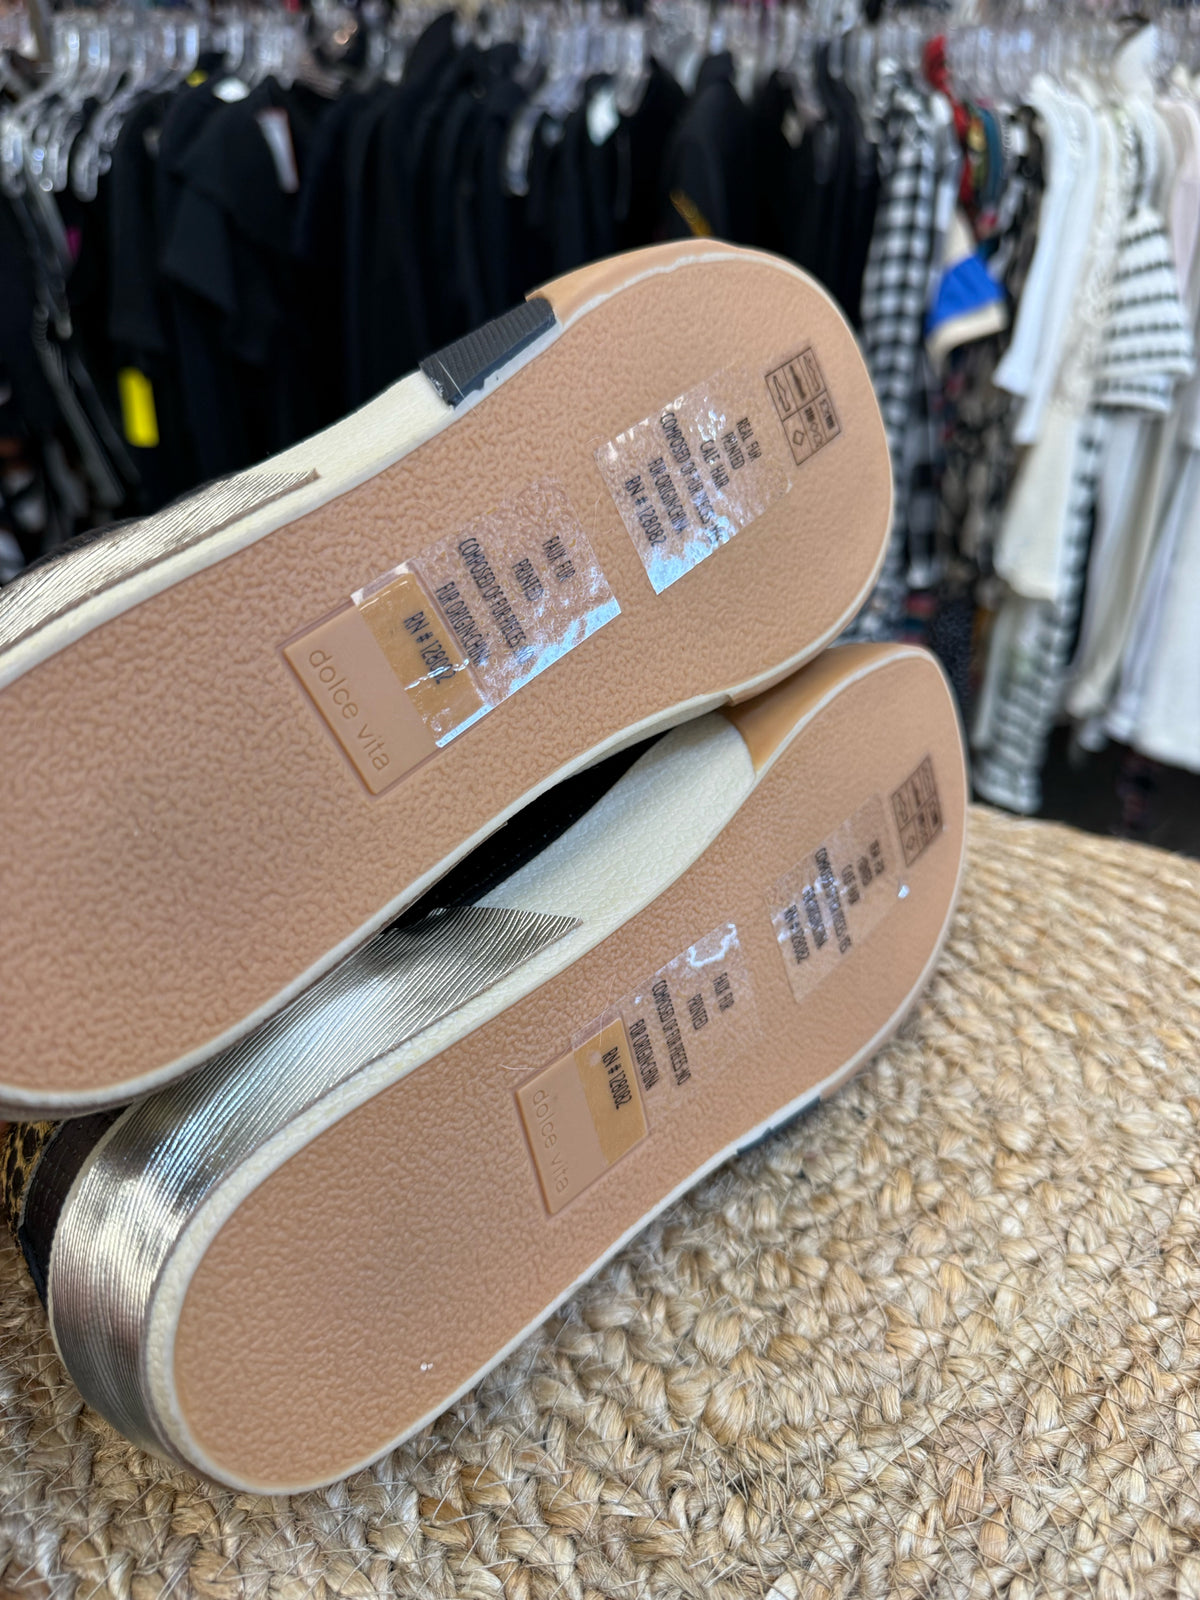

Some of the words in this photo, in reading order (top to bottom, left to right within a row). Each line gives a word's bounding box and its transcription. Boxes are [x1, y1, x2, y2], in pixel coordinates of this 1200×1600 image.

[660, 412, 690, 463] COMPOSED
[737, 417, 754, 442] REAL
[746, 441, 762, 462] FUR
[721, 432, 745, 470] PRINTED
[648, 457, 666, 478] FUR
[681, 462, 697, 478] OF
[700, 439, 720, 464] CALF
[710, 465, 729, 490] HAIR
[625, 475, 645, 497] RN
[686, 474, 704, 496] FUR
[635, 496, 646, 506] #
[638, 504, 666, 547] 128082
[459, 538, 495, 589] COMPOSED
[542, 536, 566, 567] FAUX
[555, 560, 575, 582] FUR
[512, 558, 544, 601] PRINTED
[436, 581, 460, 605] FUR
[483, 586, 503, 599] OF
[489, 597, 511, 620] FUR
[404, 611, 430, 636] RN
[500, 613, 526, 649] PIECES
[416, 632, 433, 643] #
[309, 650, 358, 719] dolce
[358, 724, 390, 770] vita
[713, 972, 730, 995] FAUX
[652, 980, 674, 1022] COMPOSED
[688, 993, 708, 1030] PRINTED
[720, 992, 735, 1012] FUR
[630, 1018, 646, 1039] FUR
[663, 1019, 678, 1033] OF
[666, 1028, 681, 1048] FUR
[602, 1046, 620, 1068] RN
[670, 1042, 688, 1072] PIECES
[608, 1064, 621, 1075] #
[609, 1070, 632, 1110] 128082
[533, 1090, 557, 1148] dolce
[552, 1152, 568, 1192] vita
